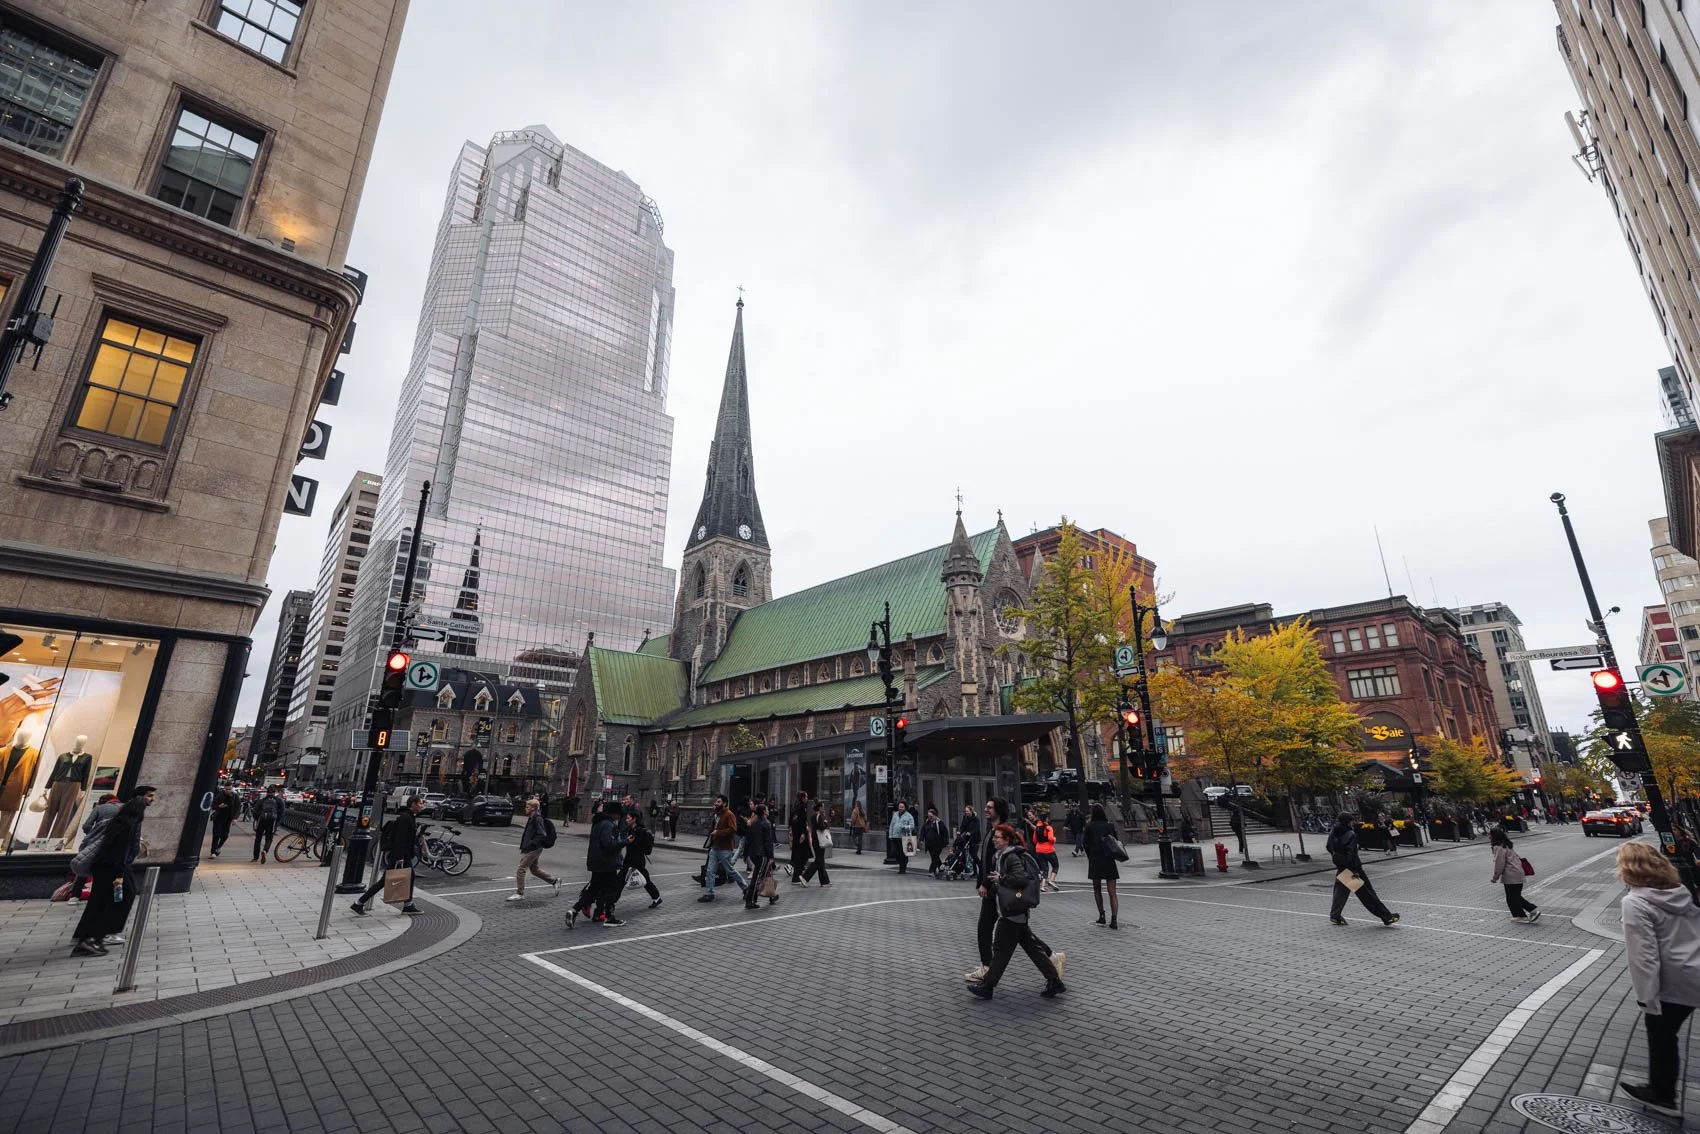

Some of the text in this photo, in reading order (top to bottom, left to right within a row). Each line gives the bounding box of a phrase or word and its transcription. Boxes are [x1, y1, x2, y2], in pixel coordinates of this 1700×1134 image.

[427, 619, 480, 631] Sainte-Catherine
[1510, 651, 1578, 660] Robert-Bourassa
[377, 731, 387, 746] 8
[1371, 725, 1405, 740] Baie
